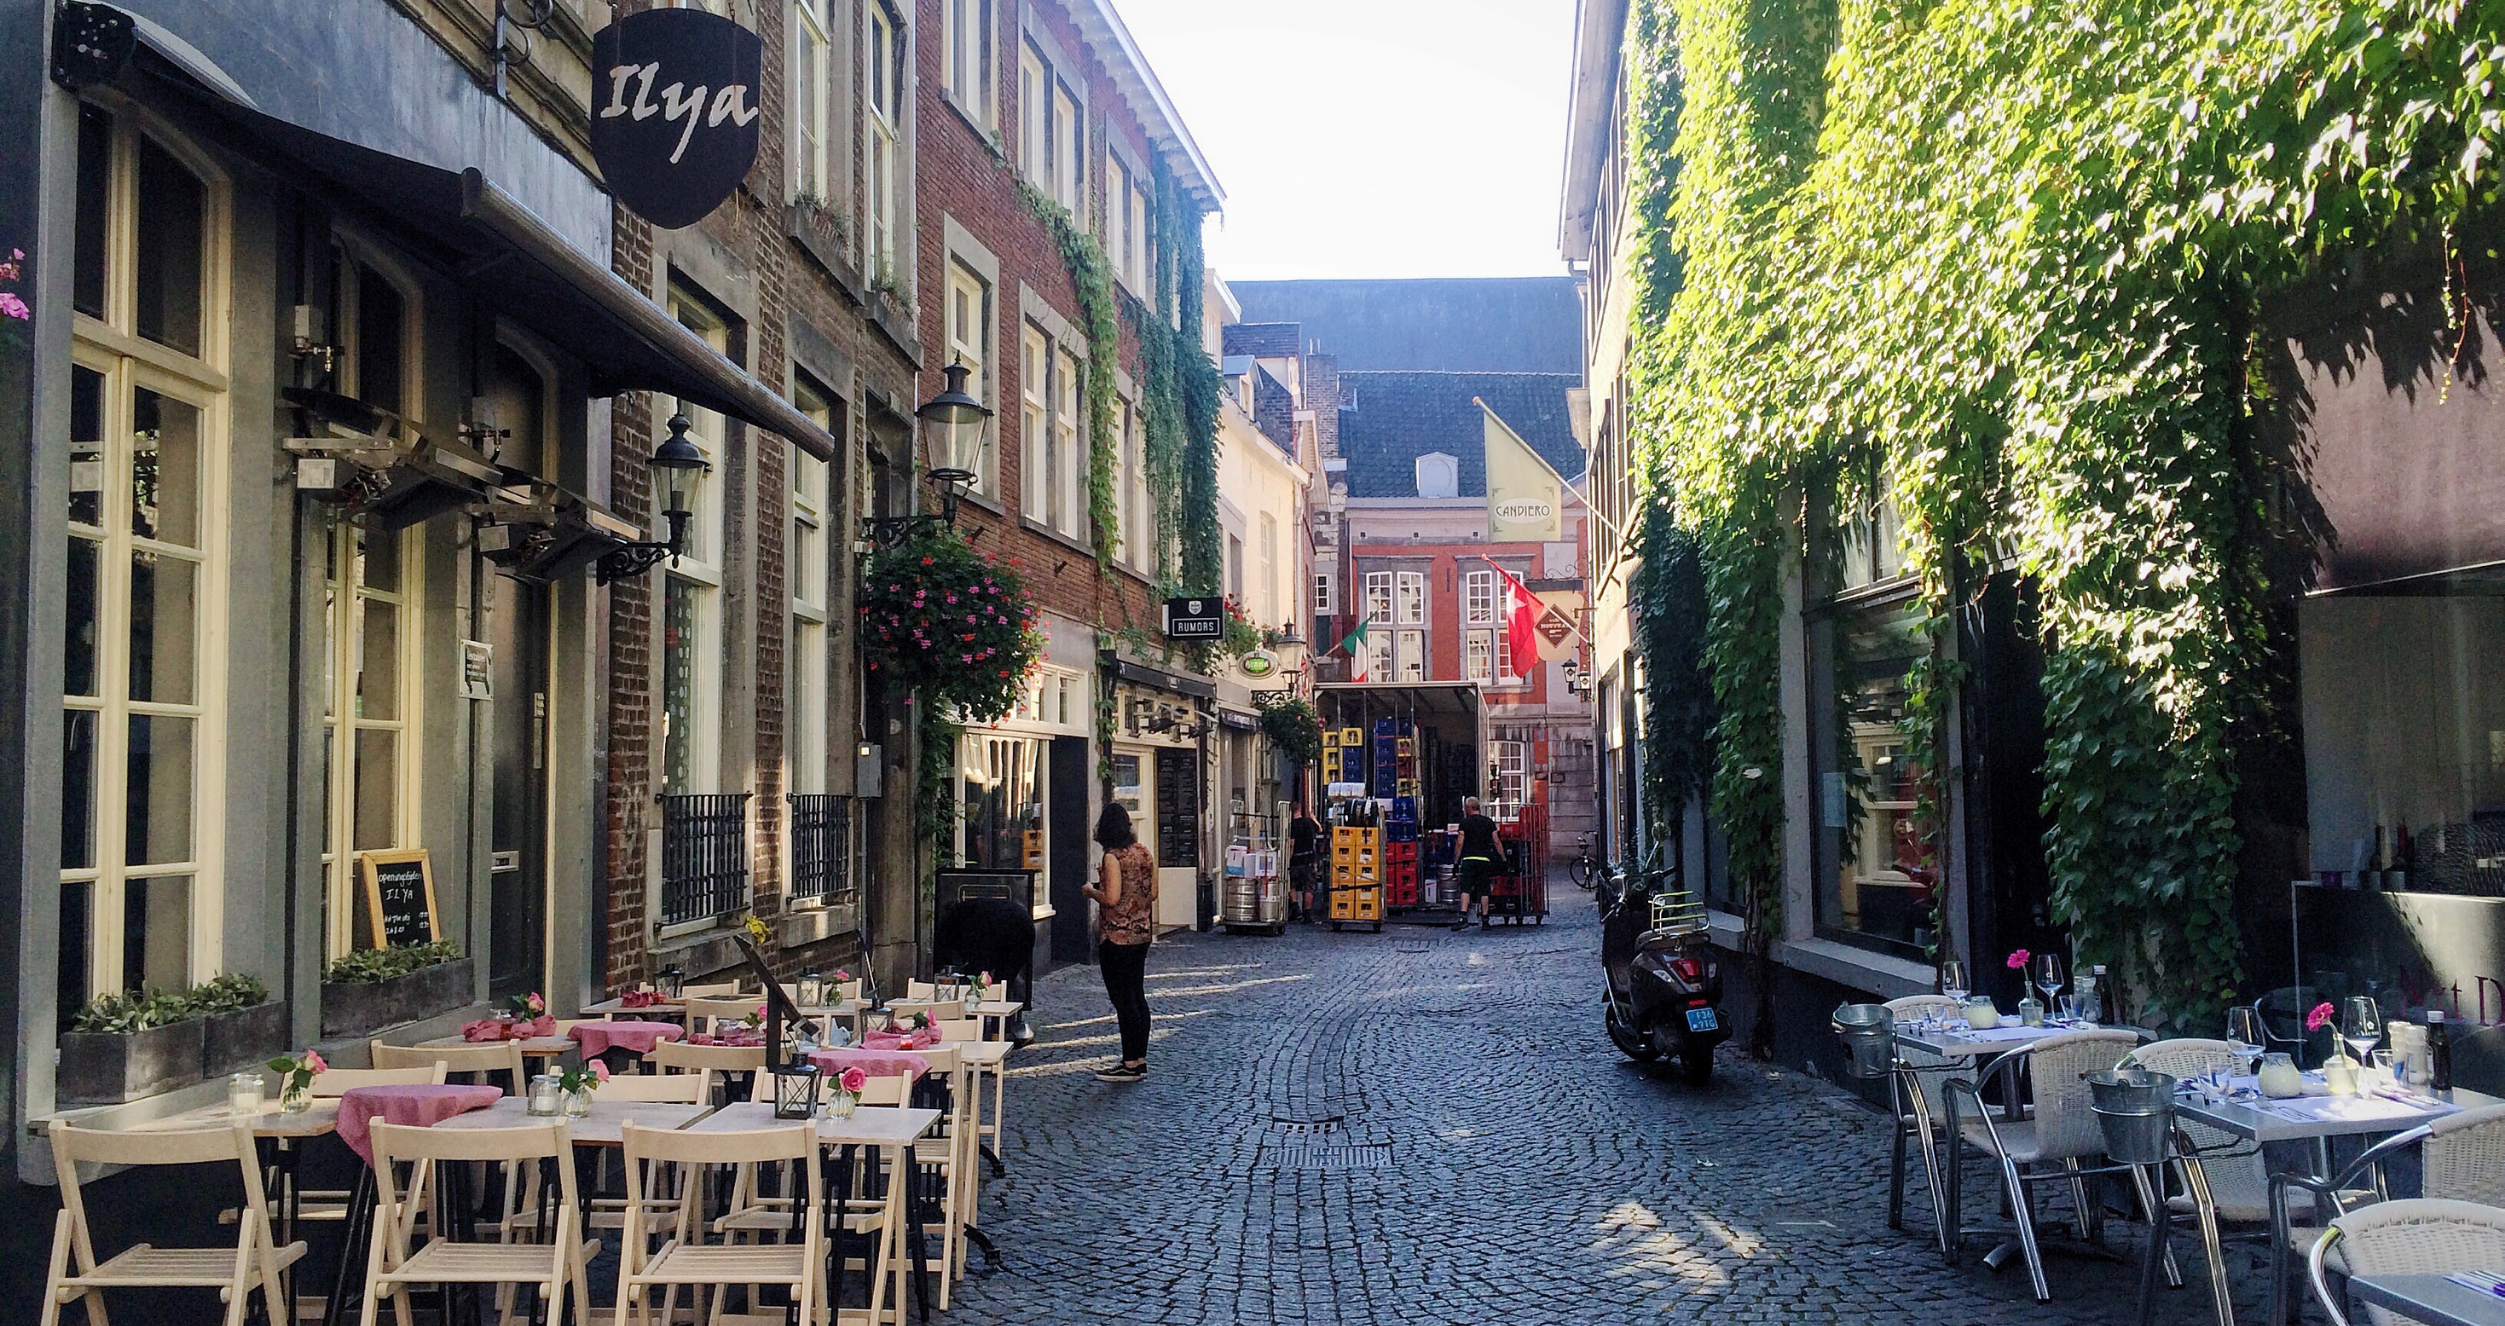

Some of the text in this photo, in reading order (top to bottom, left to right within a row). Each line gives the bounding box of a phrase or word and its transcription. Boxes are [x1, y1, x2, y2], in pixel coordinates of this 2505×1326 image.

[600, 61, 759, 164] Ilya
[1495, 505, 1551, 518] CANDIERO
[1178, 621, 1215, 632] RUMORS
[1696, 1010, 1713, 1020] F36
